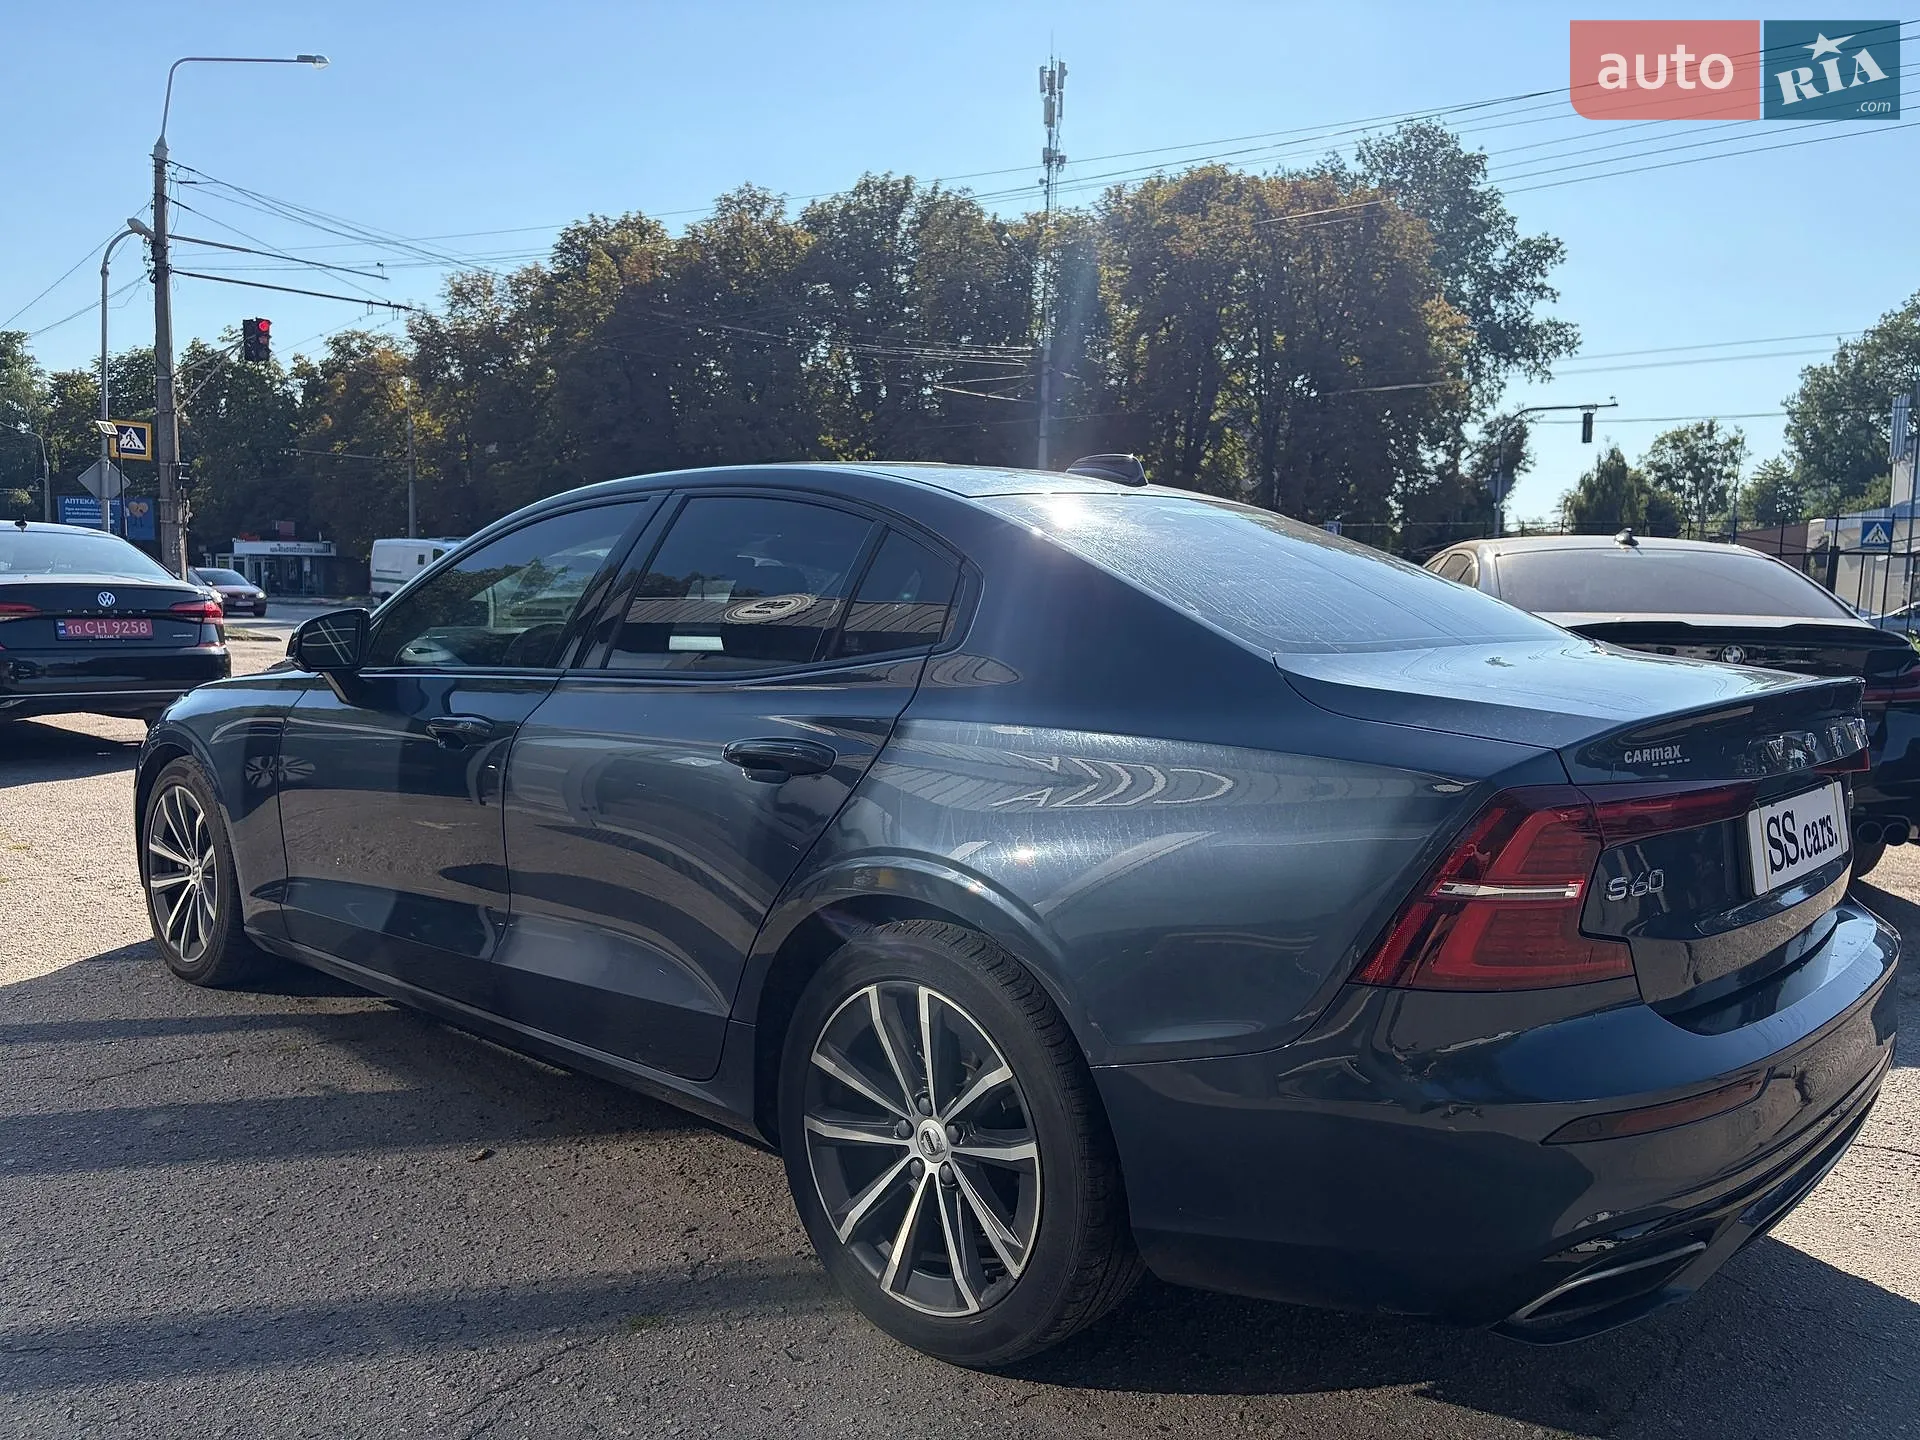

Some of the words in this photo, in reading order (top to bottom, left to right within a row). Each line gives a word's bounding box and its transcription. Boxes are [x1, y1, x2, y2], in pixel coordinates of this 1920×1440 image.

[68, 625, 82, 635] 10
[84, 621, 107, 634] CH
[112, 621, 148, 634] 9258
[1766, 809, 1838, 875] SS.cars.
[1607, 869, 1664, 901] S60
